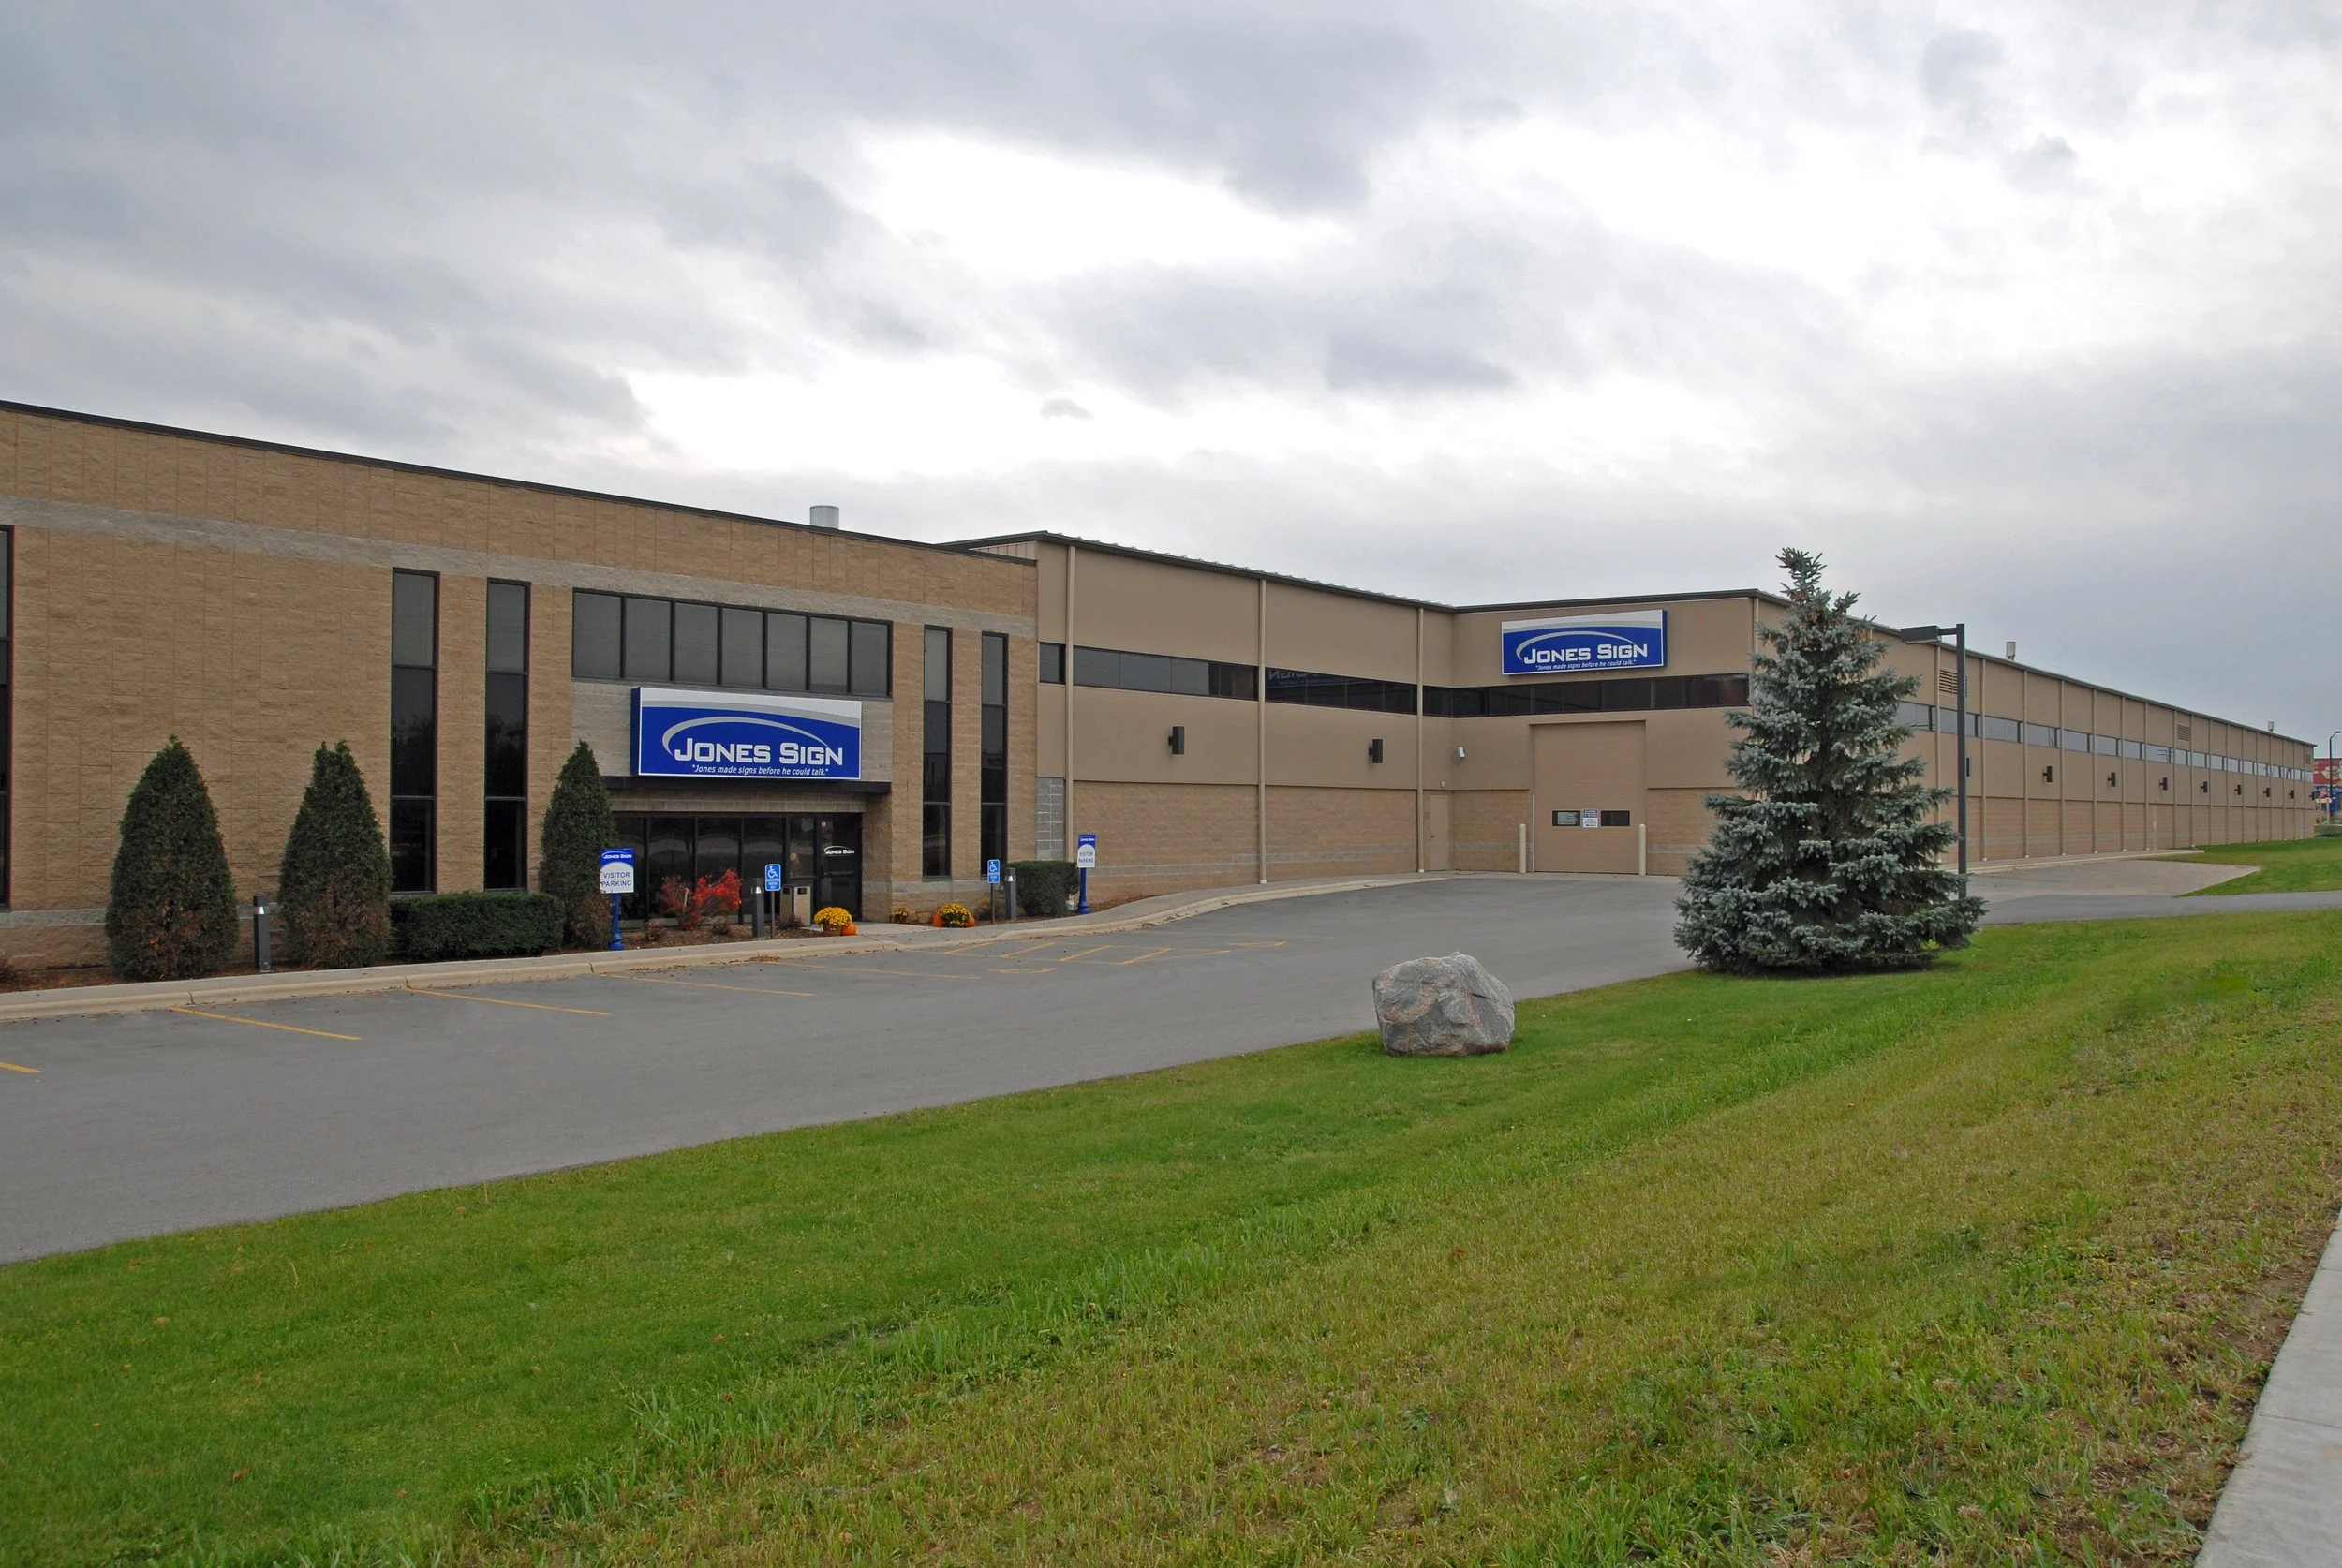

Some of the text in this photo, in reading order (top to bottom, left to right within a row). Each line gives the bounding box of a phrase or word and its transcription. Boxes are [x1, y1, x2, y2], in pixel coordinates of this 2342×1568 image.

[1524, 643, 1648, 664] JONES SIGN
[674, 737, 843, 766] JONES SIGN
[717, 765, 737, 774] made
[738, 766, 757, 776] signs
[758, 766, 781, 775] before
[782, 767, 792, 776] he
[792, 767, 810, 776] could
